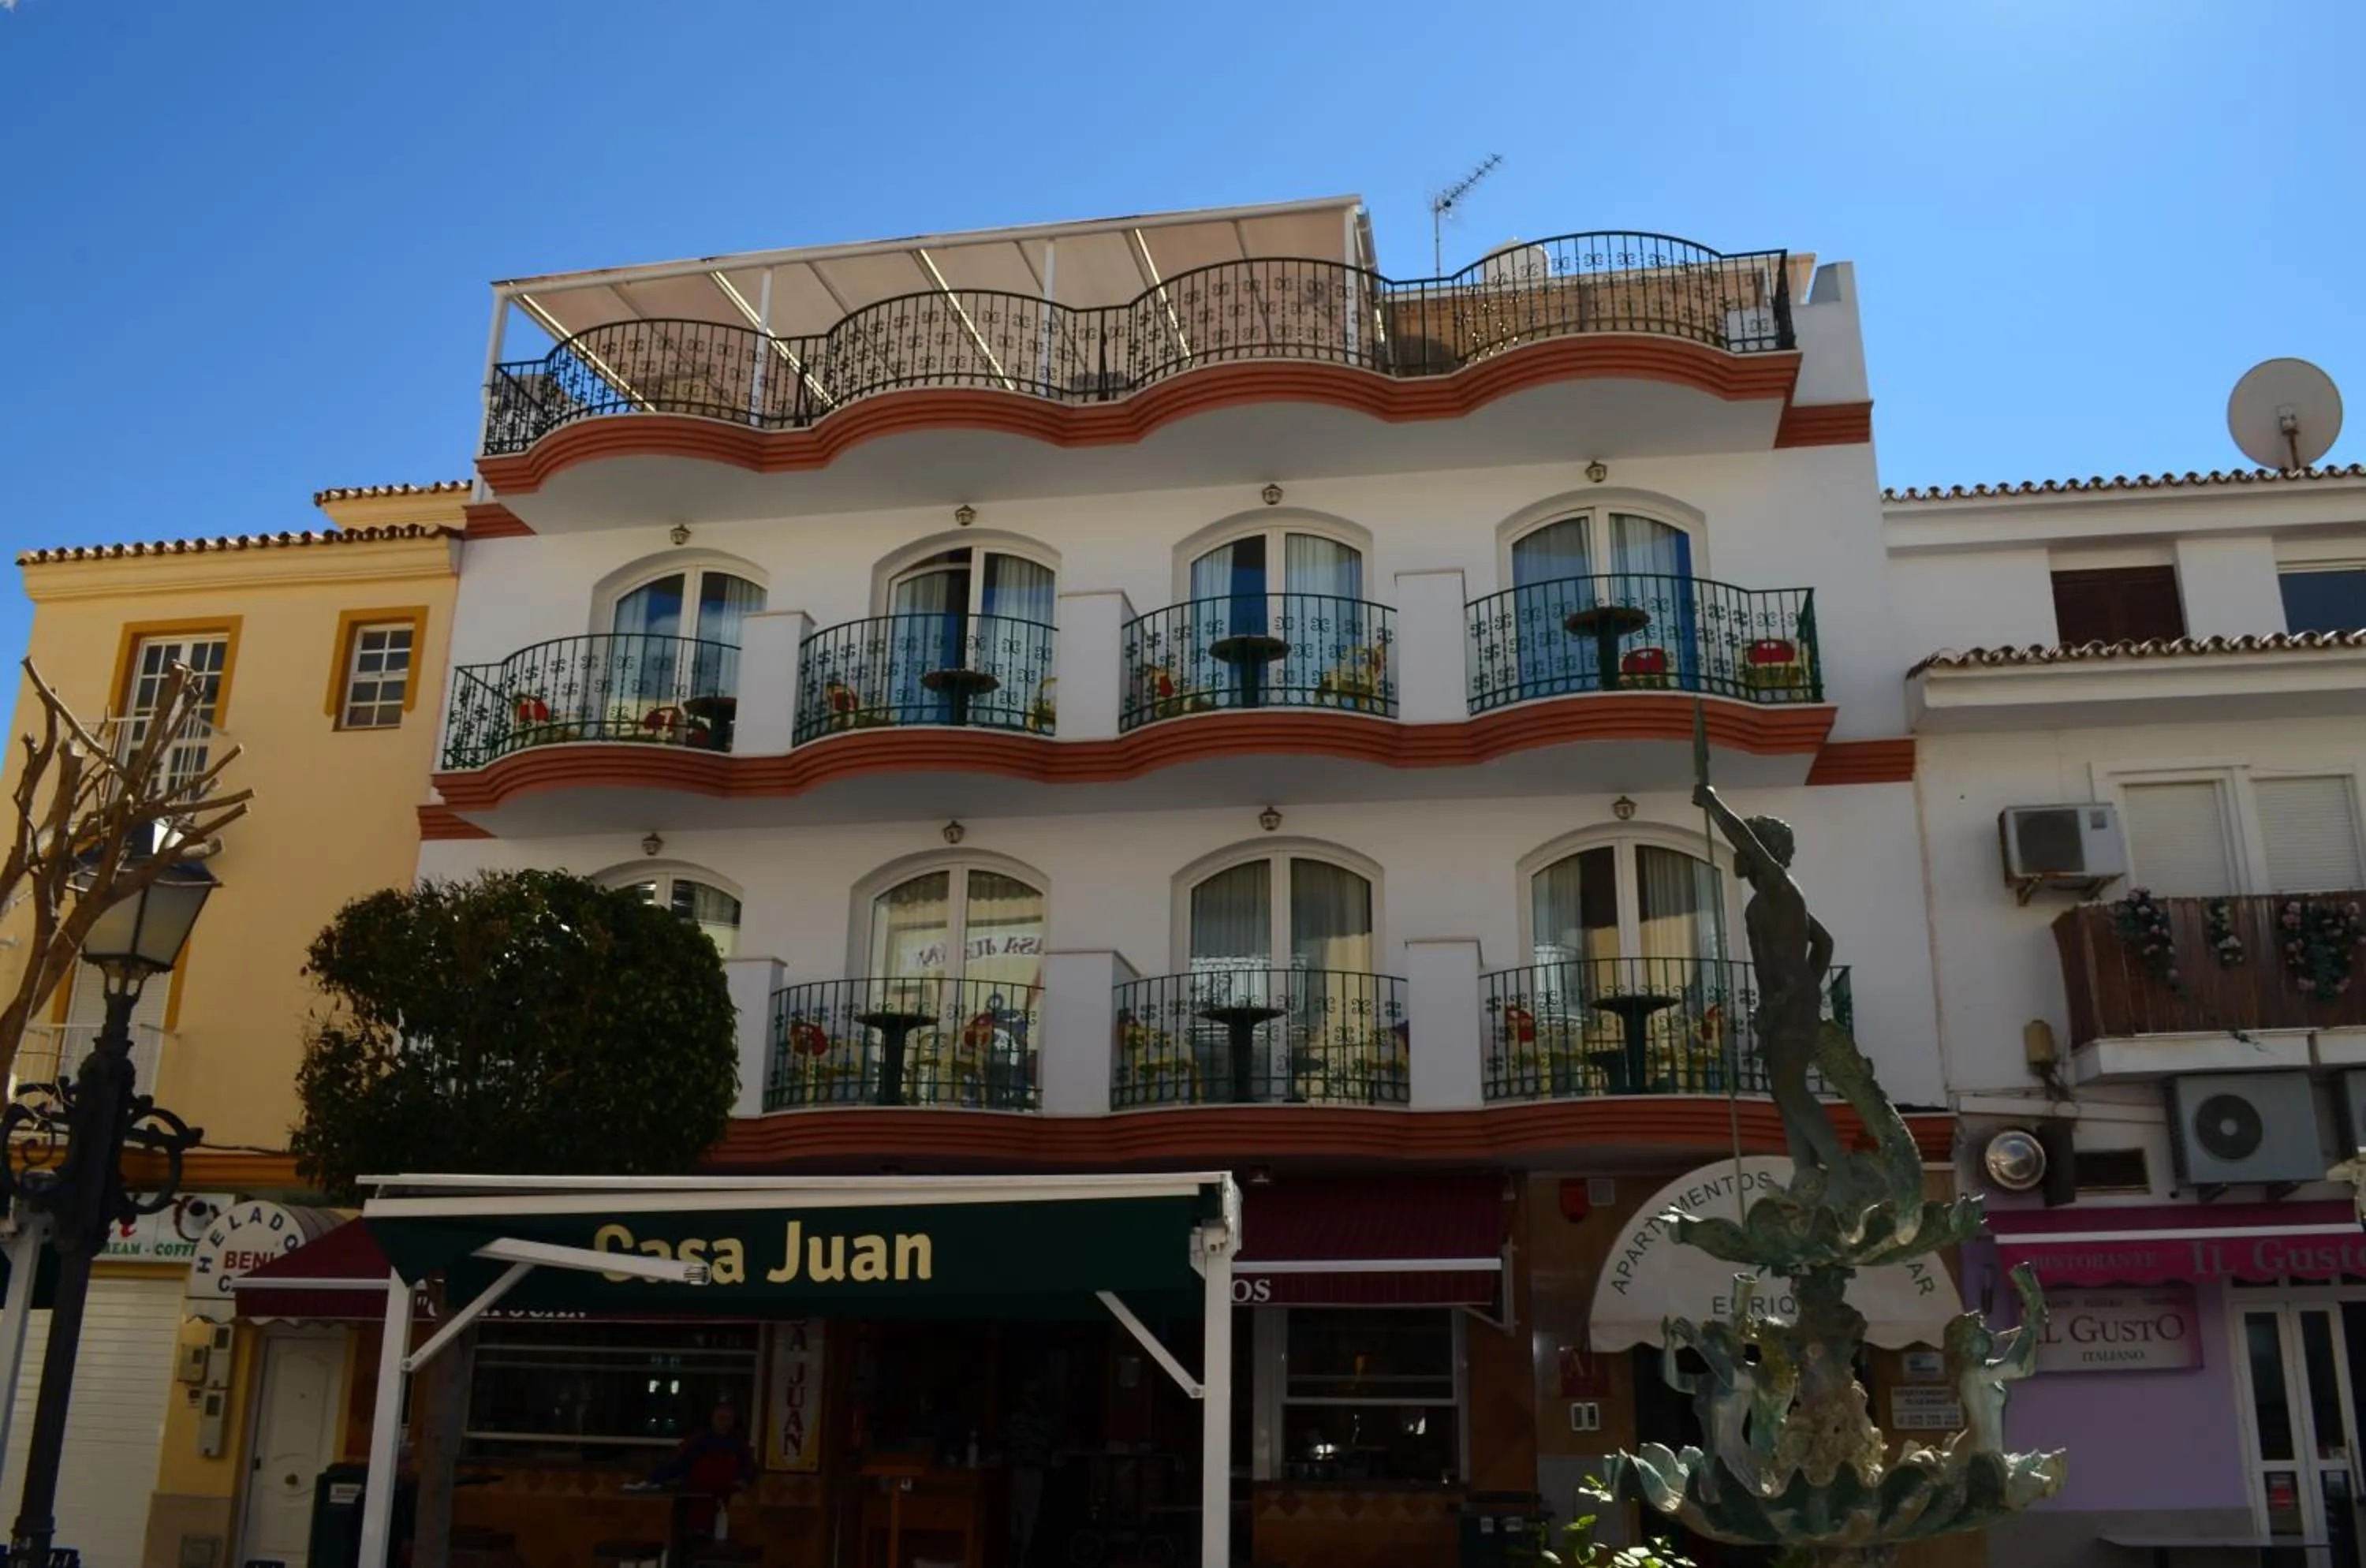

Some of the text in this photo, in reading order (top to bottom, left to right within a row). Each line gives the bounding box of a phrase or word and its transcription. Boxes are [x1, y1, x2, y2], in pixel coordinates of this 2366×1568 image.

[766, 1220, 932, 1283] Juan
[1713, 1296, 1796, 1315] ERIQ
[2069, 1313, 2184, 1342] GUSTO
[2082, 1350, 2145, 1362] ITALIANO
[783, 1363, 807, 1456] JUAN
